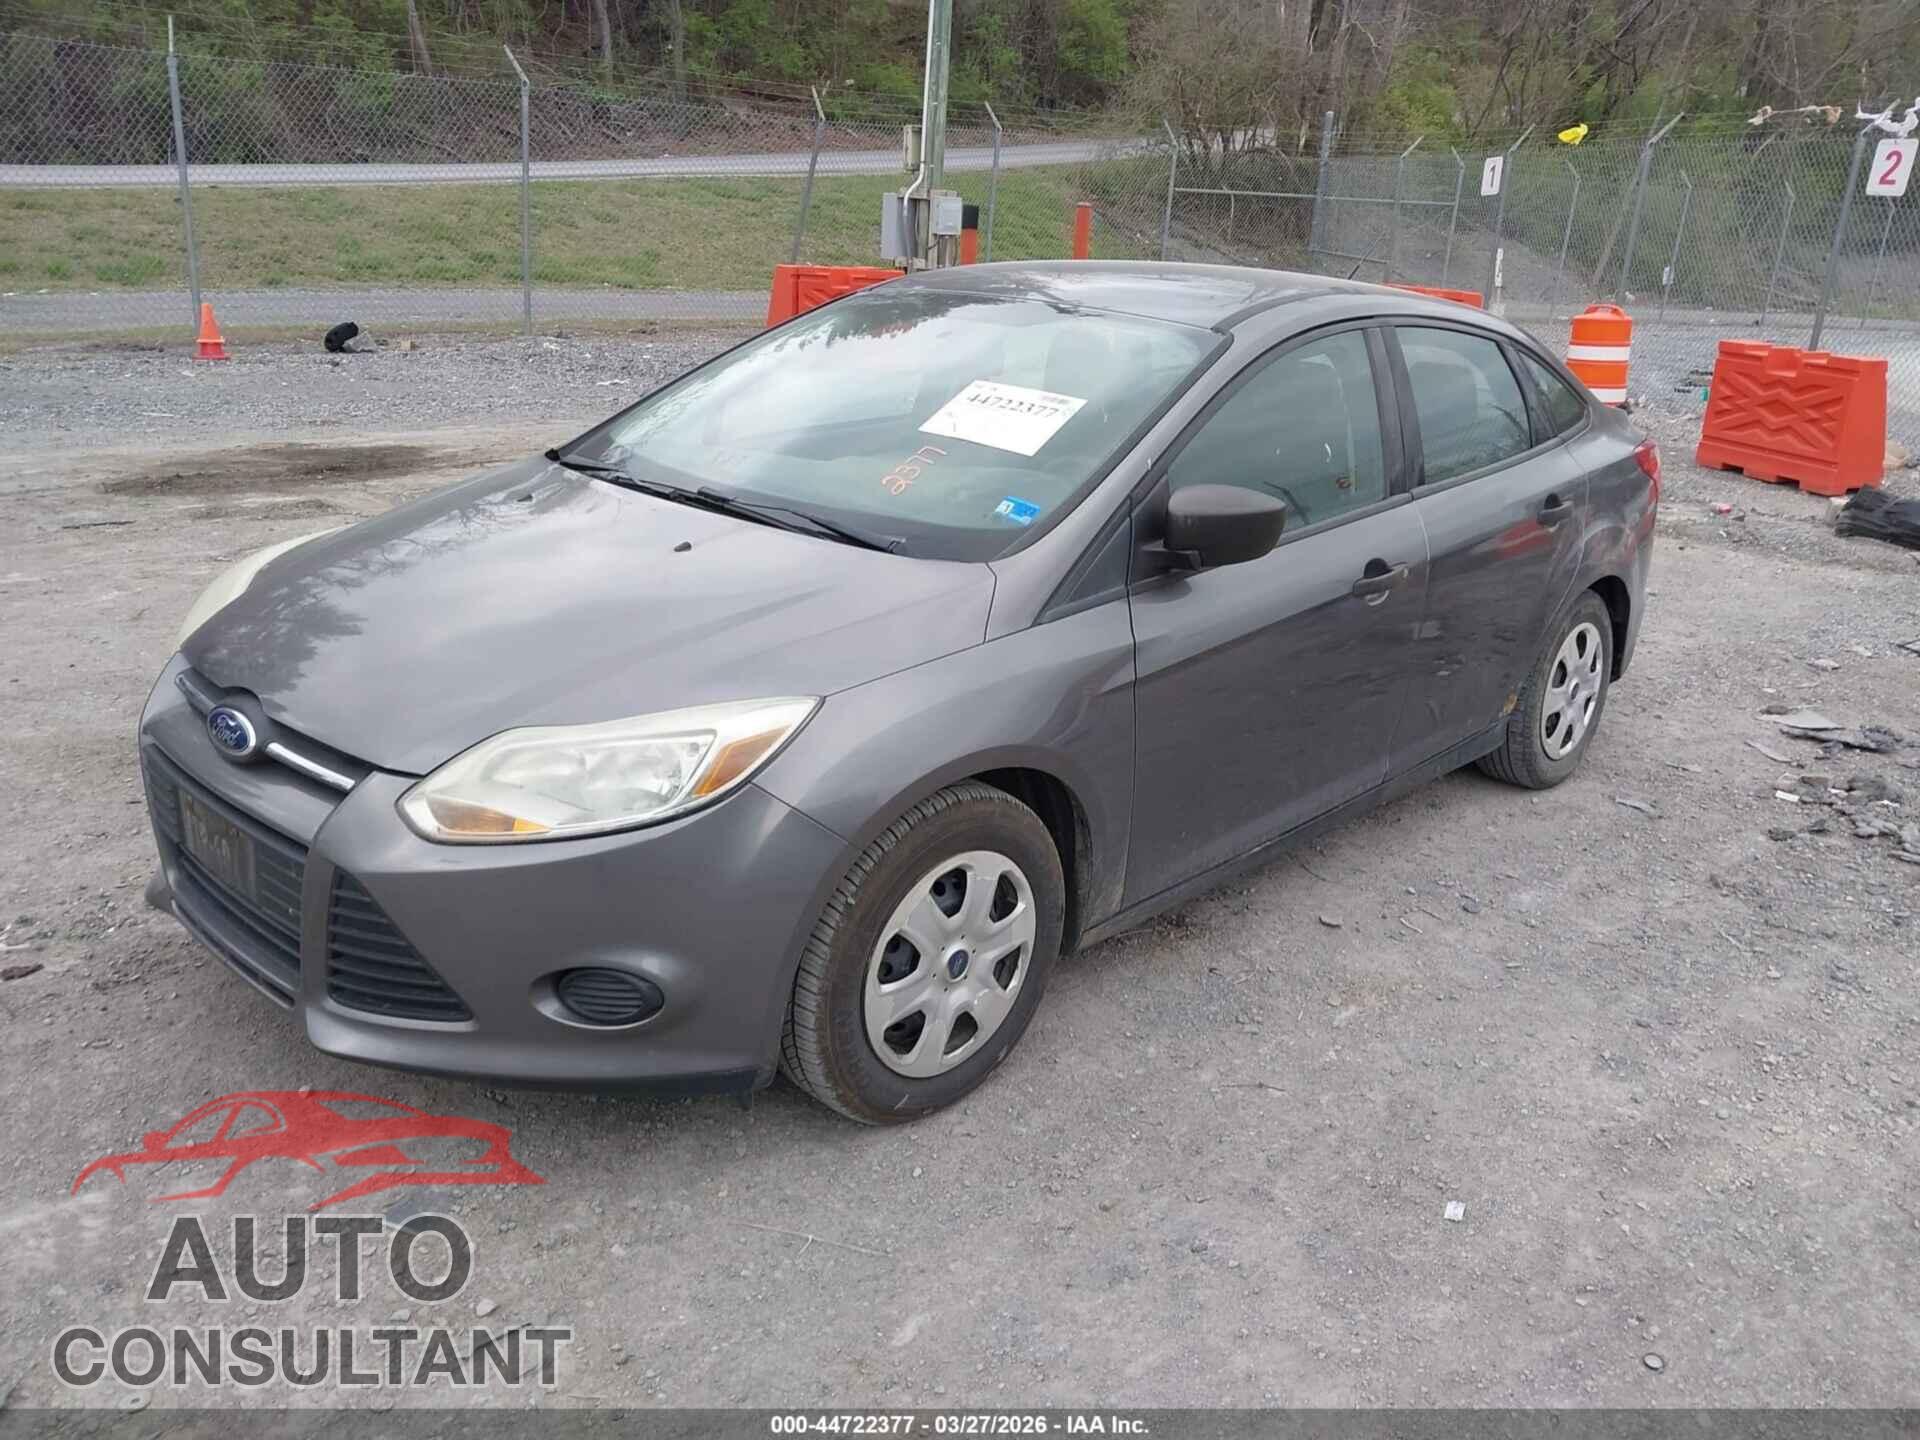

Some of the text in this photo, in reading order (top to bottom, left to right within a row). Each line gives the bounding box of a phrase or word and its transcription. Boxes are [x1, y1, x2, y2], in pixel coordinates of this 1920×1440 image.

[1489, 164, 1497, 188] 1
[1878, 149, 1903, 185] 2
[967, 392, 1060, 418] 44722377
[881, 446, 948, 495] 2377
